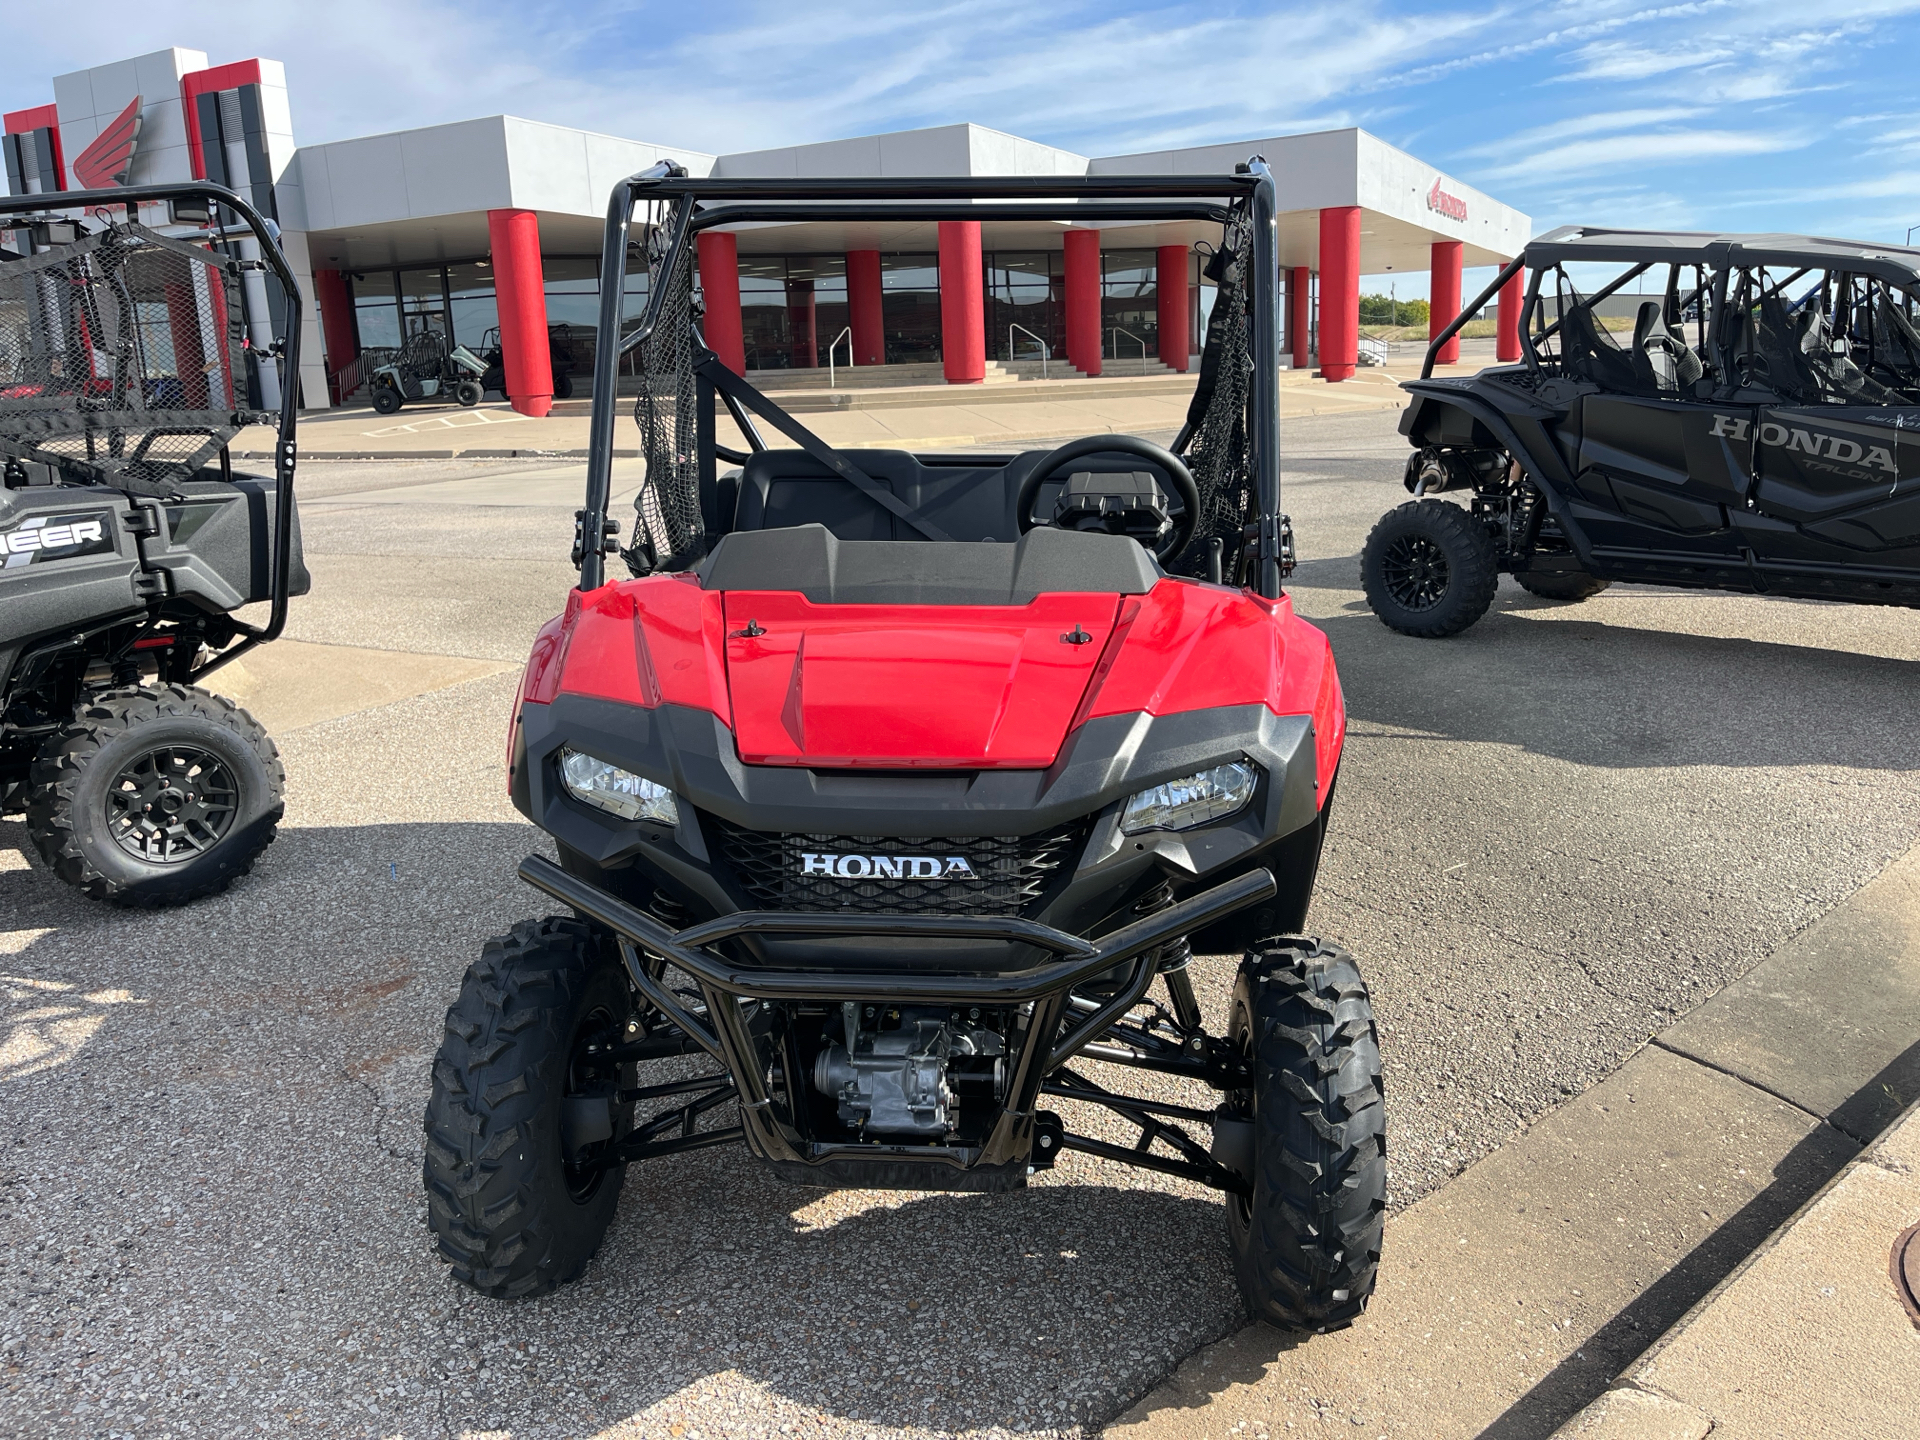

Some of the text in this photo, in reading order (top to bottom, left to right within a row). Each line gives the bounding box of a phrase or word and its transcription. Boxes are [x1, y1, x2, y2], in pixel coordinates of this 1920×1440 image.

[1708, 413, 1900, 475] HONDA
[1802, 459, 1885, 483] TALON
[801, 853, 980, 880] HONDA
